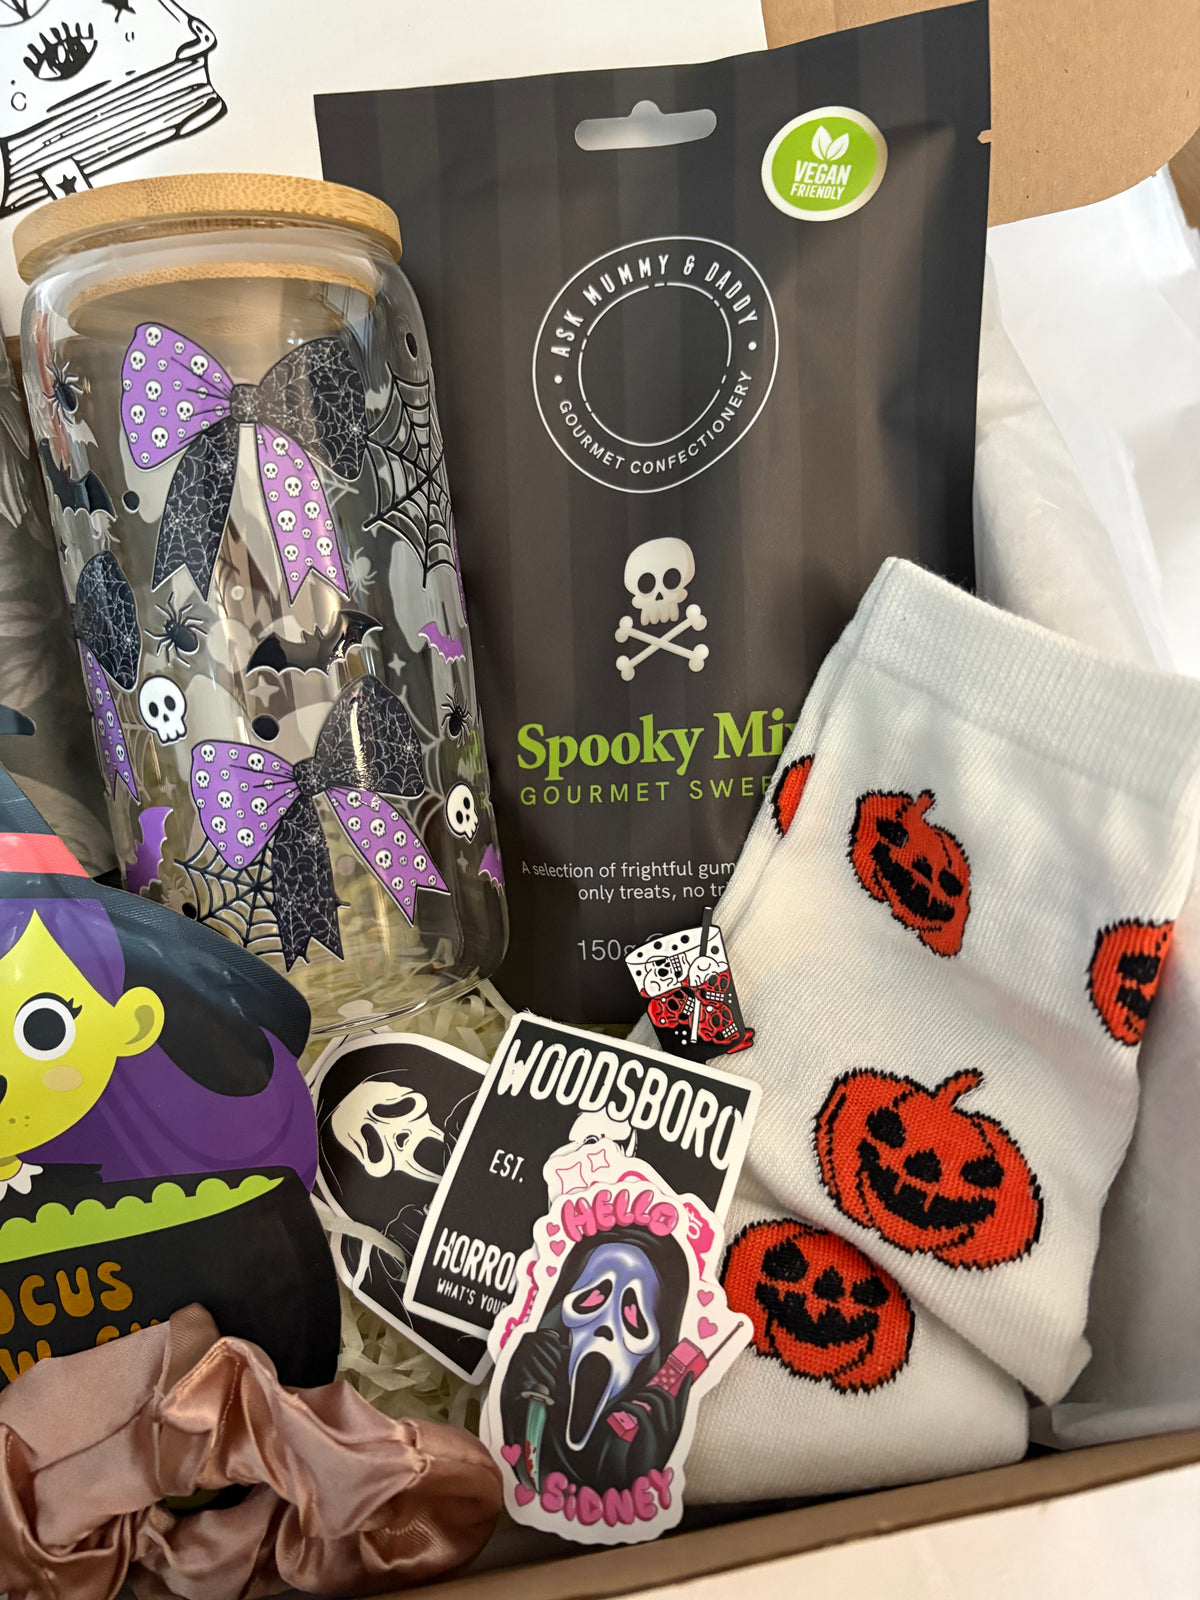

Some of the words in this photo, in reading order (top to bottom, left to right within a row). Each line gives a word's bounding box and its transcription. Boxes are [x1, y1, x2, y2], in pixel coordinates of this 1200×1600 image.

[794, 160, 852, 186] VEGAN
[790, 183, 846, 201] FRIENDLY
[550, 309, 584, 358] ASK
[582, 254, 670, 307] MUMMY
[682, 254, 696, 276] &
[704, 261, 758, 326] DADDY
[559, 400, 625, 471] GOURMET
[630, 370, 752, 475] CONFECTIONERY
[516, 713, 705, 781] Spooky
[712, 708, 796, 760] Mi
[520, 781, 670, 806] GOURMET
[521, 860, 531, 875] A
[533, 861, 594, 879] selection
[599, 861, 617, 878] of
[620, 859, 693, 881] frightful
[578, 883, 614, 903] only
[619, 883, 677, 901] treats,
[683, 885, 705, 898] no
[496, 1038, 743, 1171] WOODSBORO
[489, 1148, 525, 1183] EST.
[561, 1188, 680, 1243] HELLO
[436, 1277, 477, 1306] WHAT'S
